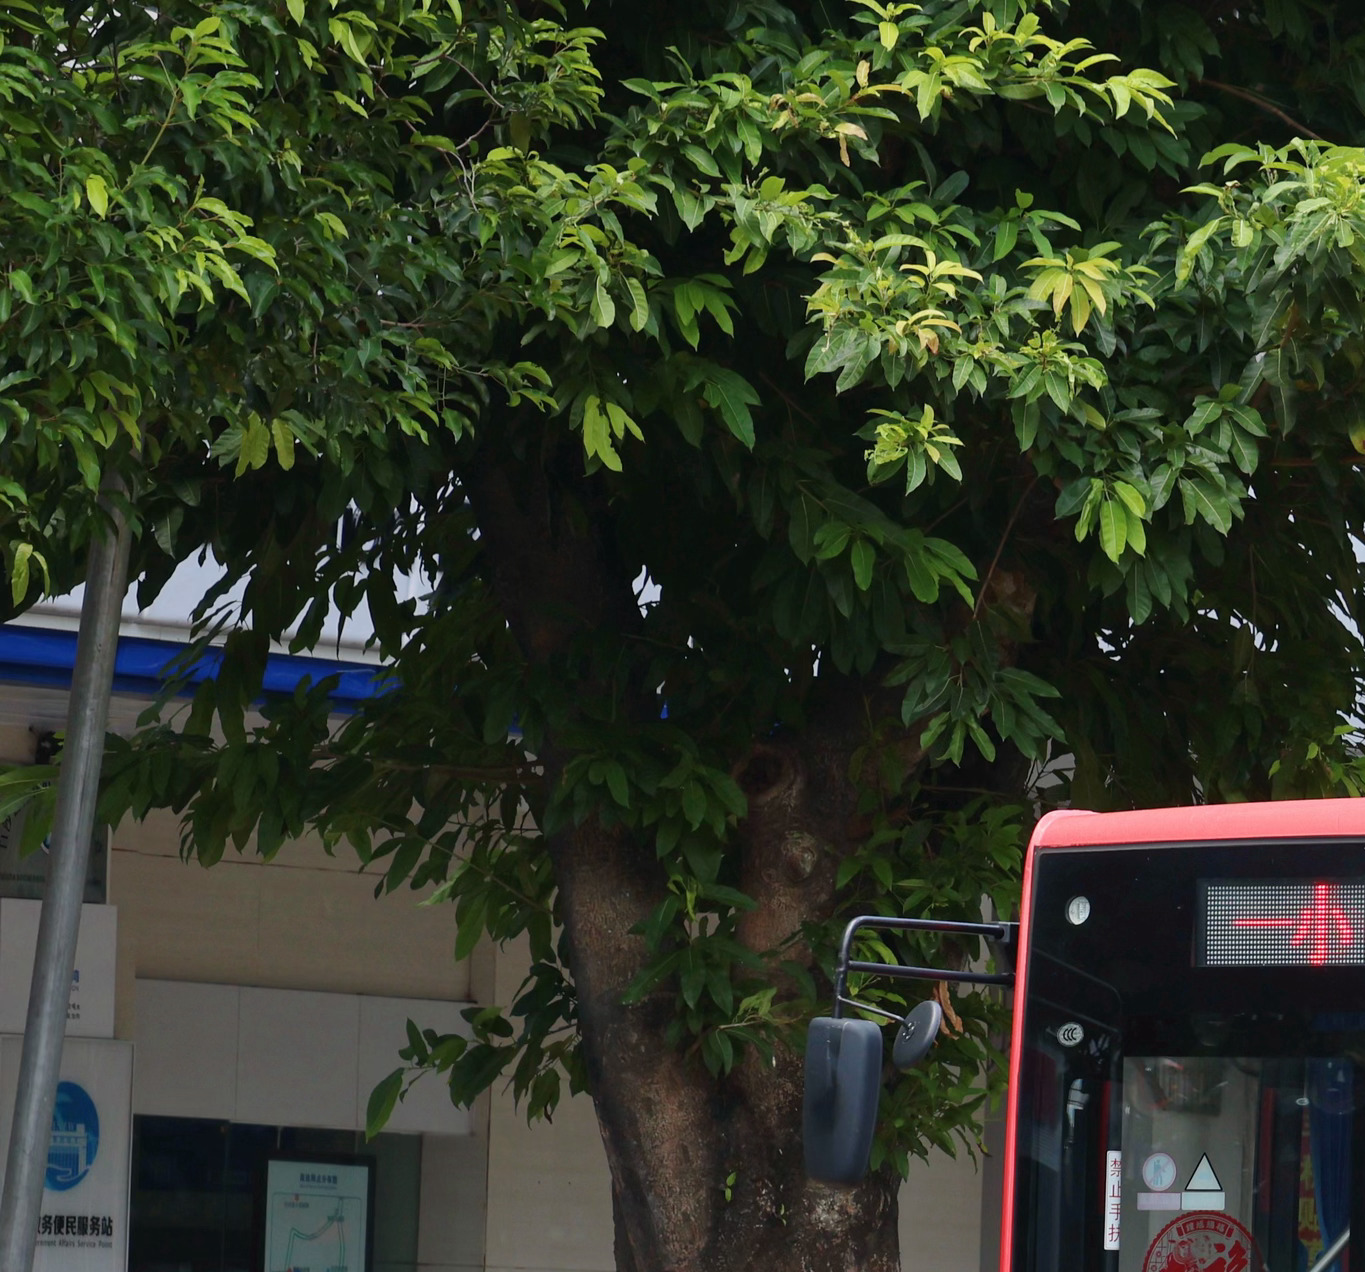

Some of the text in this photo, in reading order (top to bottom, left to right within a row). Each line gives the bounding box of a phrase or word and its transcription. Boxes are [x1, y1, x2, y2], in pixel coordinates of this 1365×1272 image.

[1233, 883, 1354, 966] 一小
[37, 1214, 113, 1237] 务便民服务站
